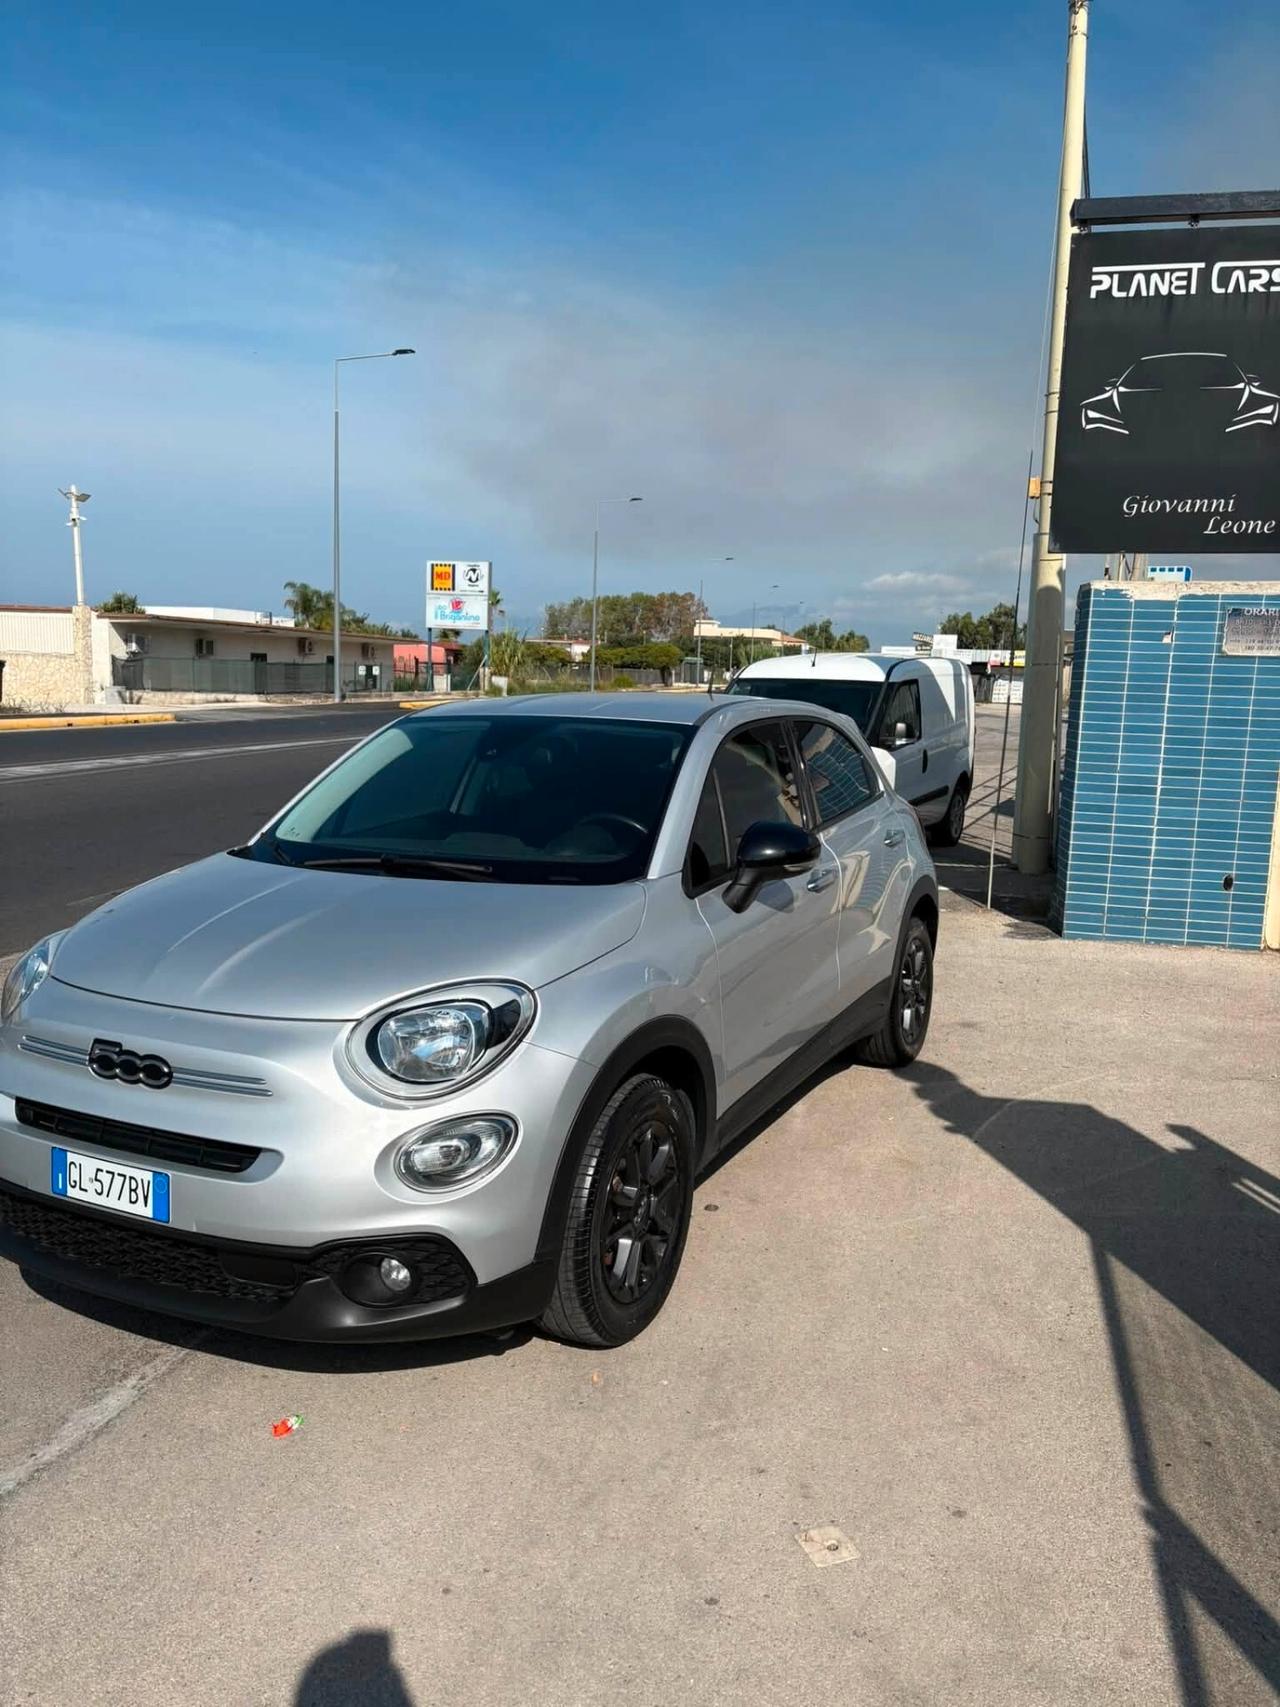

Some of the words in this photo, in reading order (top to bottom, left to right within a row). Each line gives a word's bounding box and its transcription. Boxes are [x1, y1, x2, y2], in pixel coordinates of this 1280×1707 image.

[1090, 262, 1206, 298] PLANET
[1122, 494, 1236, 519] Giovanni
[1204, 516, 1276, 535] Leone
[435, 571, 451, 580] MD
[88, 1038, 173, 1089] 500
